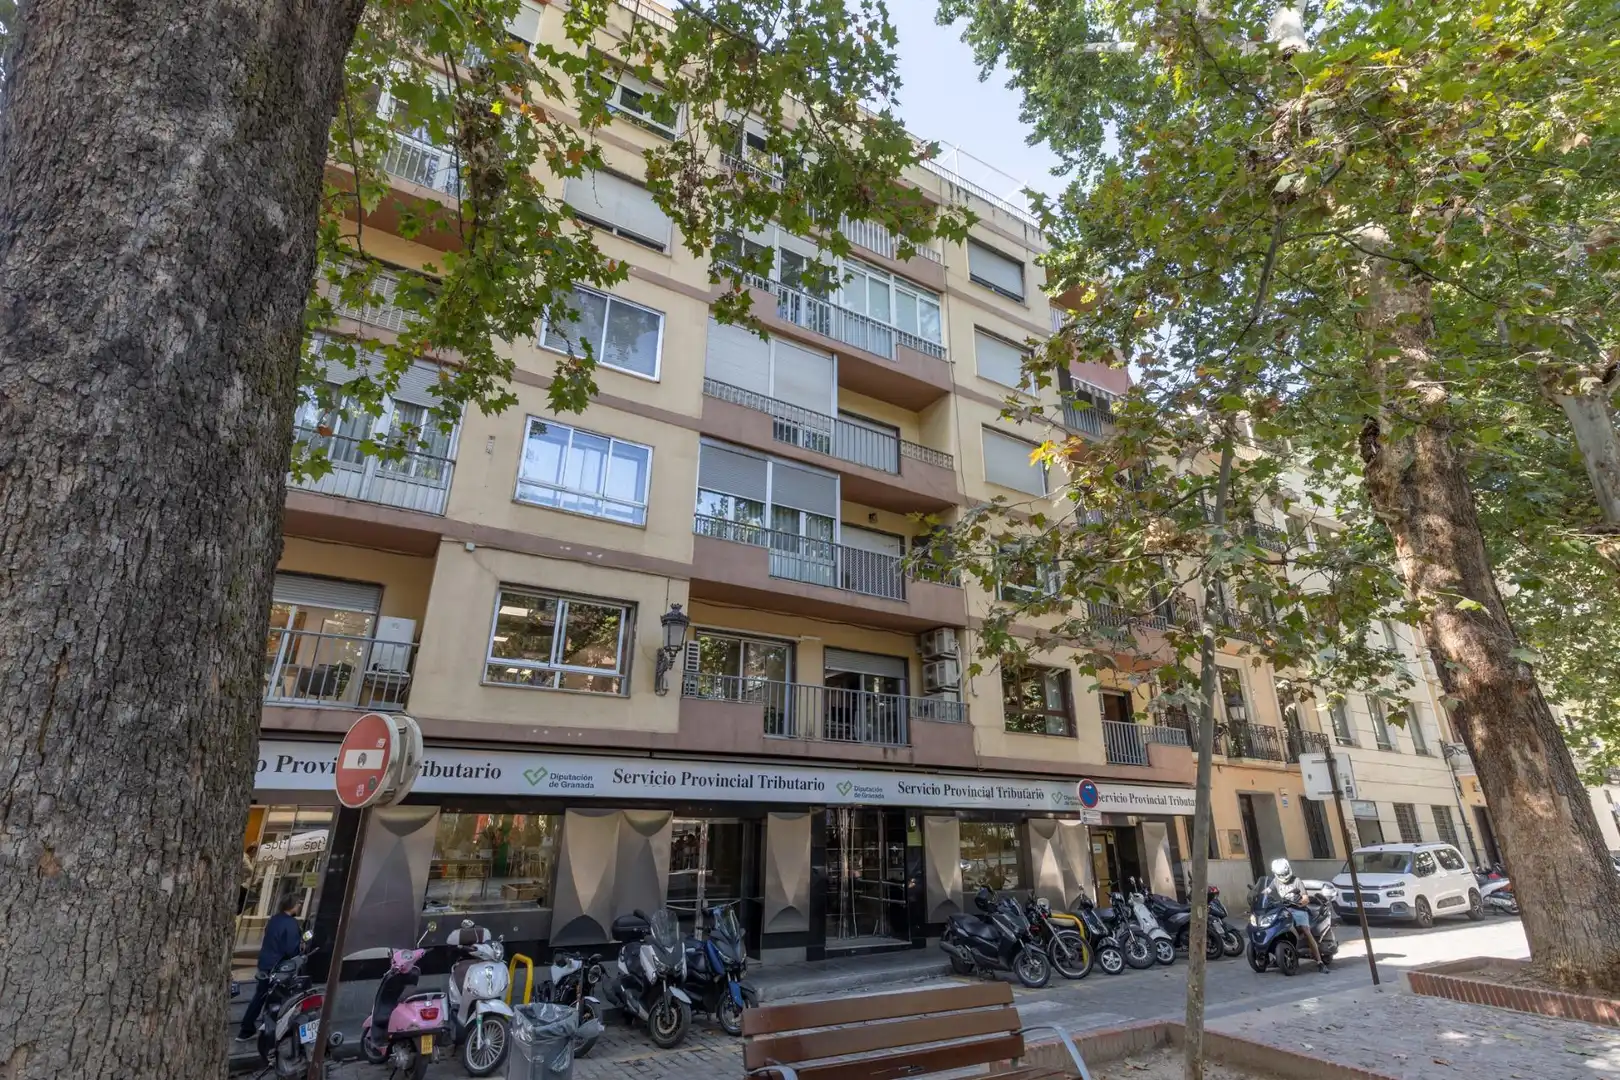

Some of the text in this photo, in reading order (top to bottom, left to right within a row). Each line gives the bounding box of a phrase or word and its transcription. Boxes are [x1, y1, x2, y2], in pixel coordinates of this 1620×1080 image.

[275, 754, 336, 774] Provi
[420, 760, 502, 780] ibutario
[550, 773, 593, 781] Diputación
[612, 768, 825, 791] Servicio Provincial Tributario
[897, 780, 1044, 800] Servicio Provincial Tributario
[1129, 794, 1168, 806] Provincial
[1169, 796, 1196, 807] Tributa
